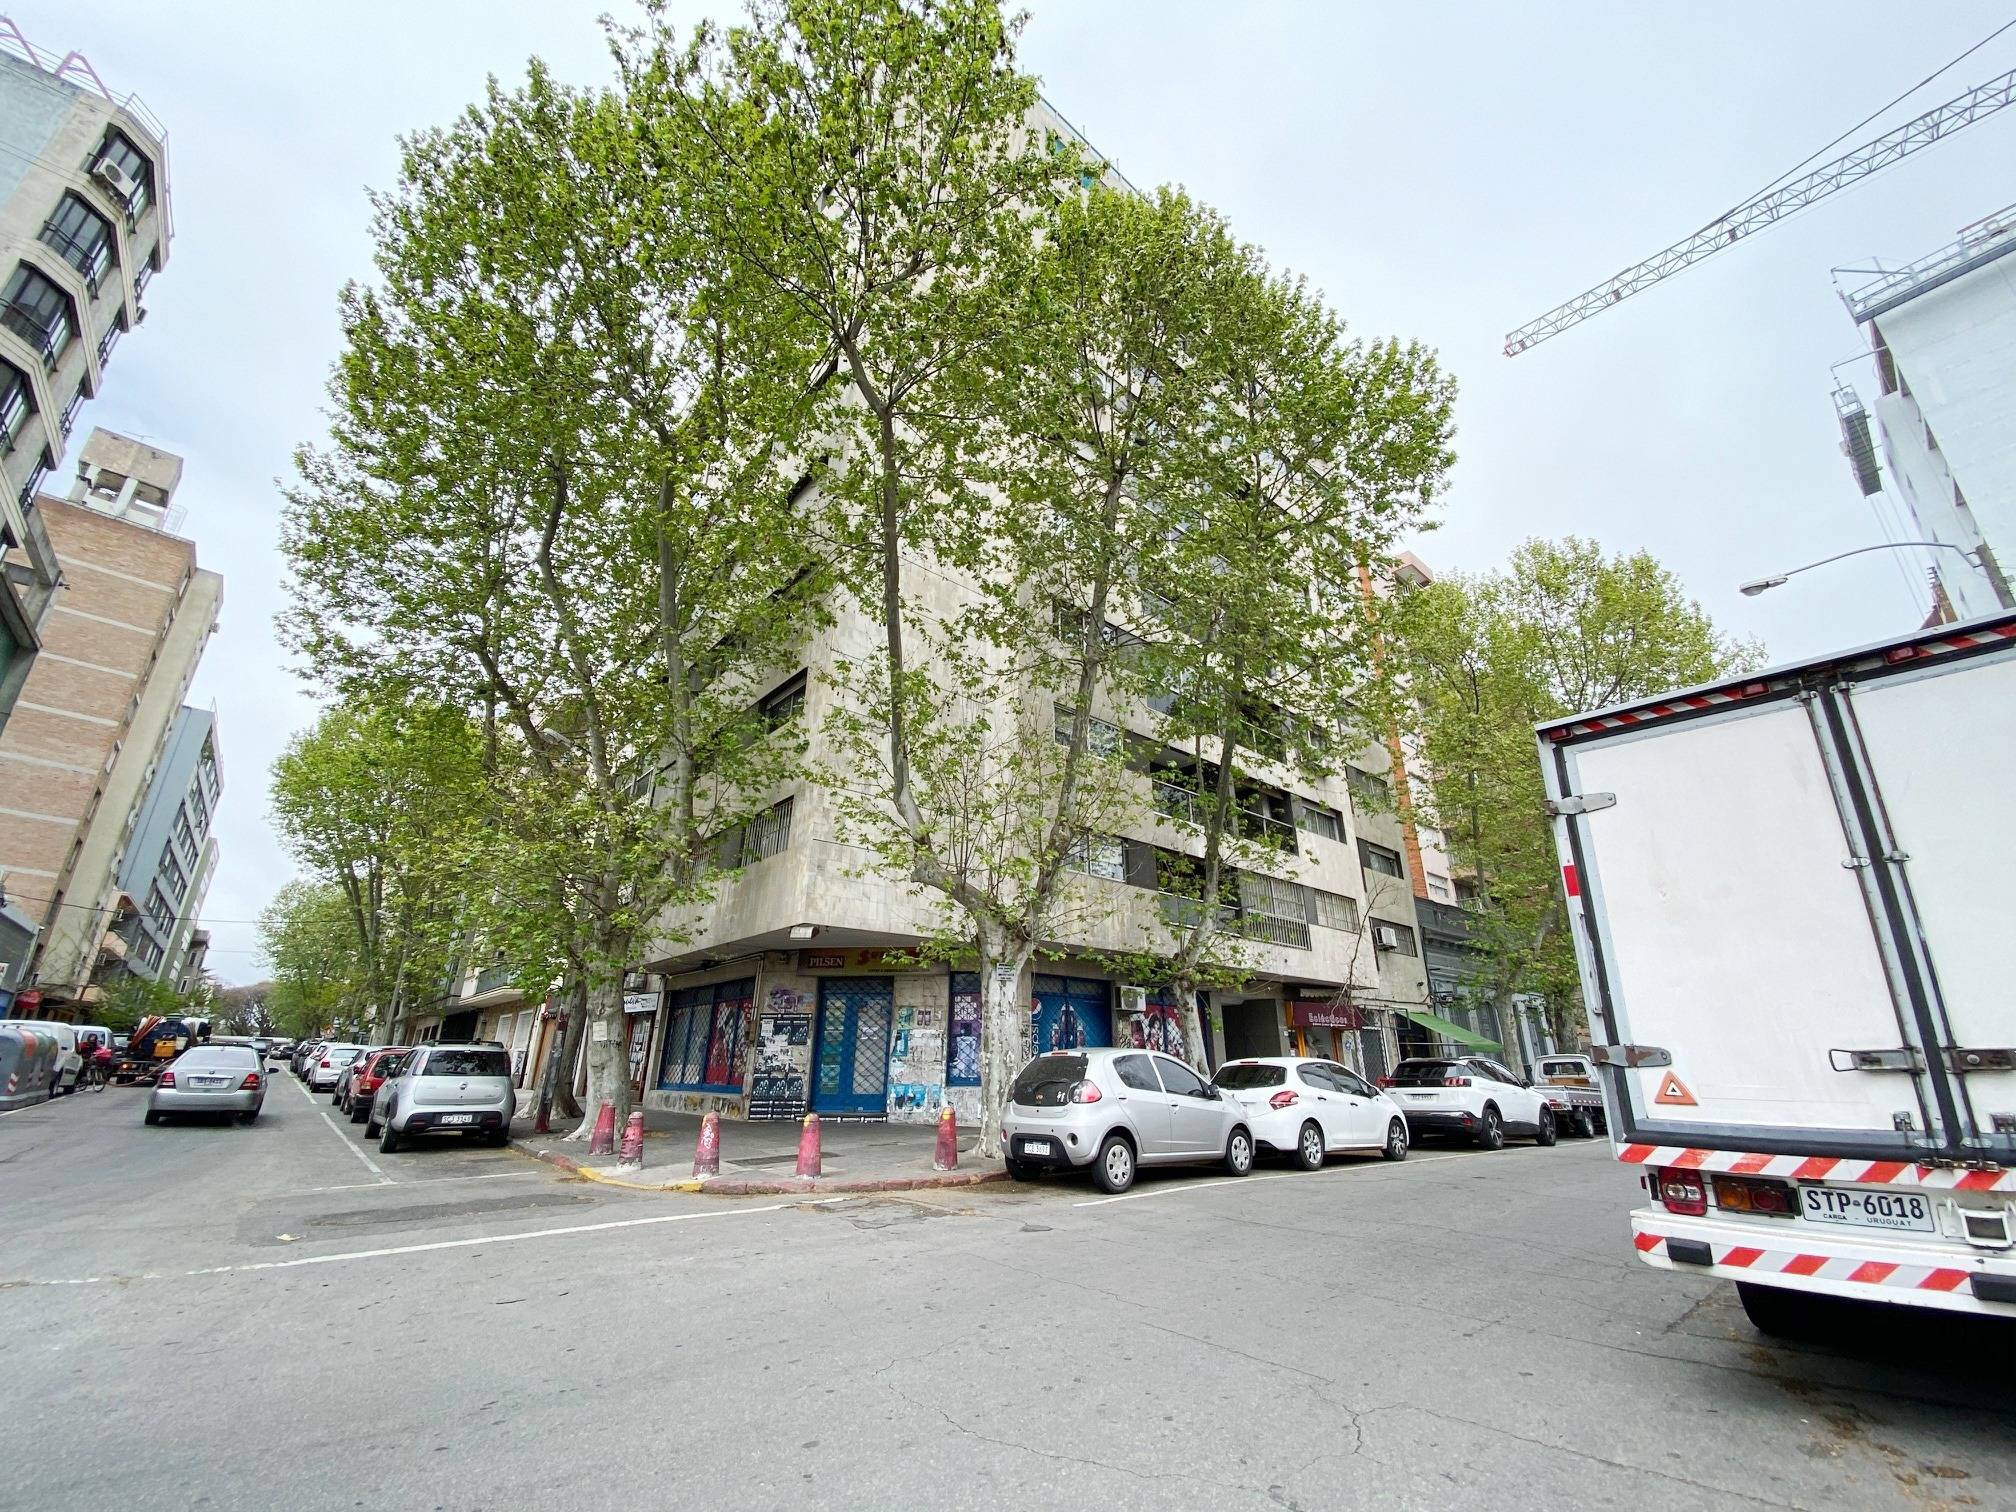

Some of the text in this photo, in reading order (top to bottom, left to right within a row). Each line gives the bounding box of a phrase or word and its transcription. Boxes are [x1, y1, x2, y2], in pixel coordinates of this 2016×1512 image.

[809, 956, 843, 967] PILSEN
[1823, 1213, 1912, 1228] CARGA URUGUAY
